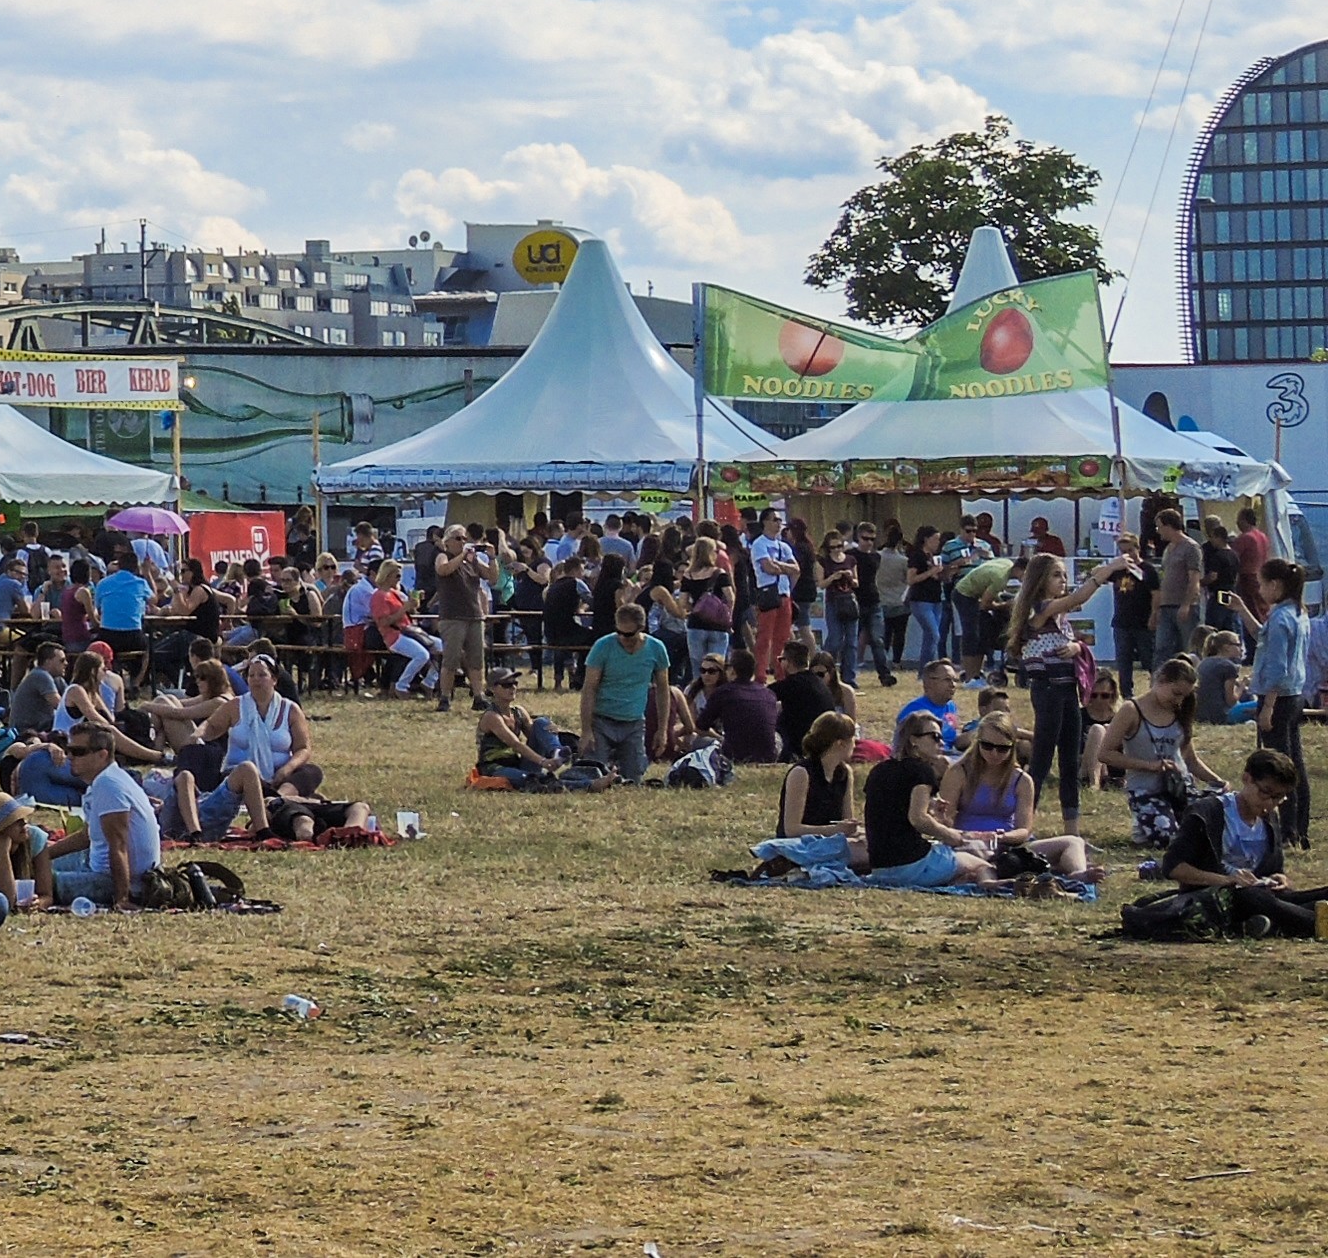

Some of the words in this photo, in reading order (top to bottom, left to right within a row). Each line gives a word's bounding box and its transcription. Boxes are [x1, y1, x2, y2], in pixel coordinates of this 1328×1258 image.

[966, 287, 1043, 332] LUCKY
[76, 368, 107, 394] BIER
[128, 367, 171, 392] KEBAB
[742, 375, 875, 400] NOODLES
[949, 369, 1074, 399] NOODLES
[640, 496, 670, 504] KASSA
[734, 493, 766, 501] KASSA
